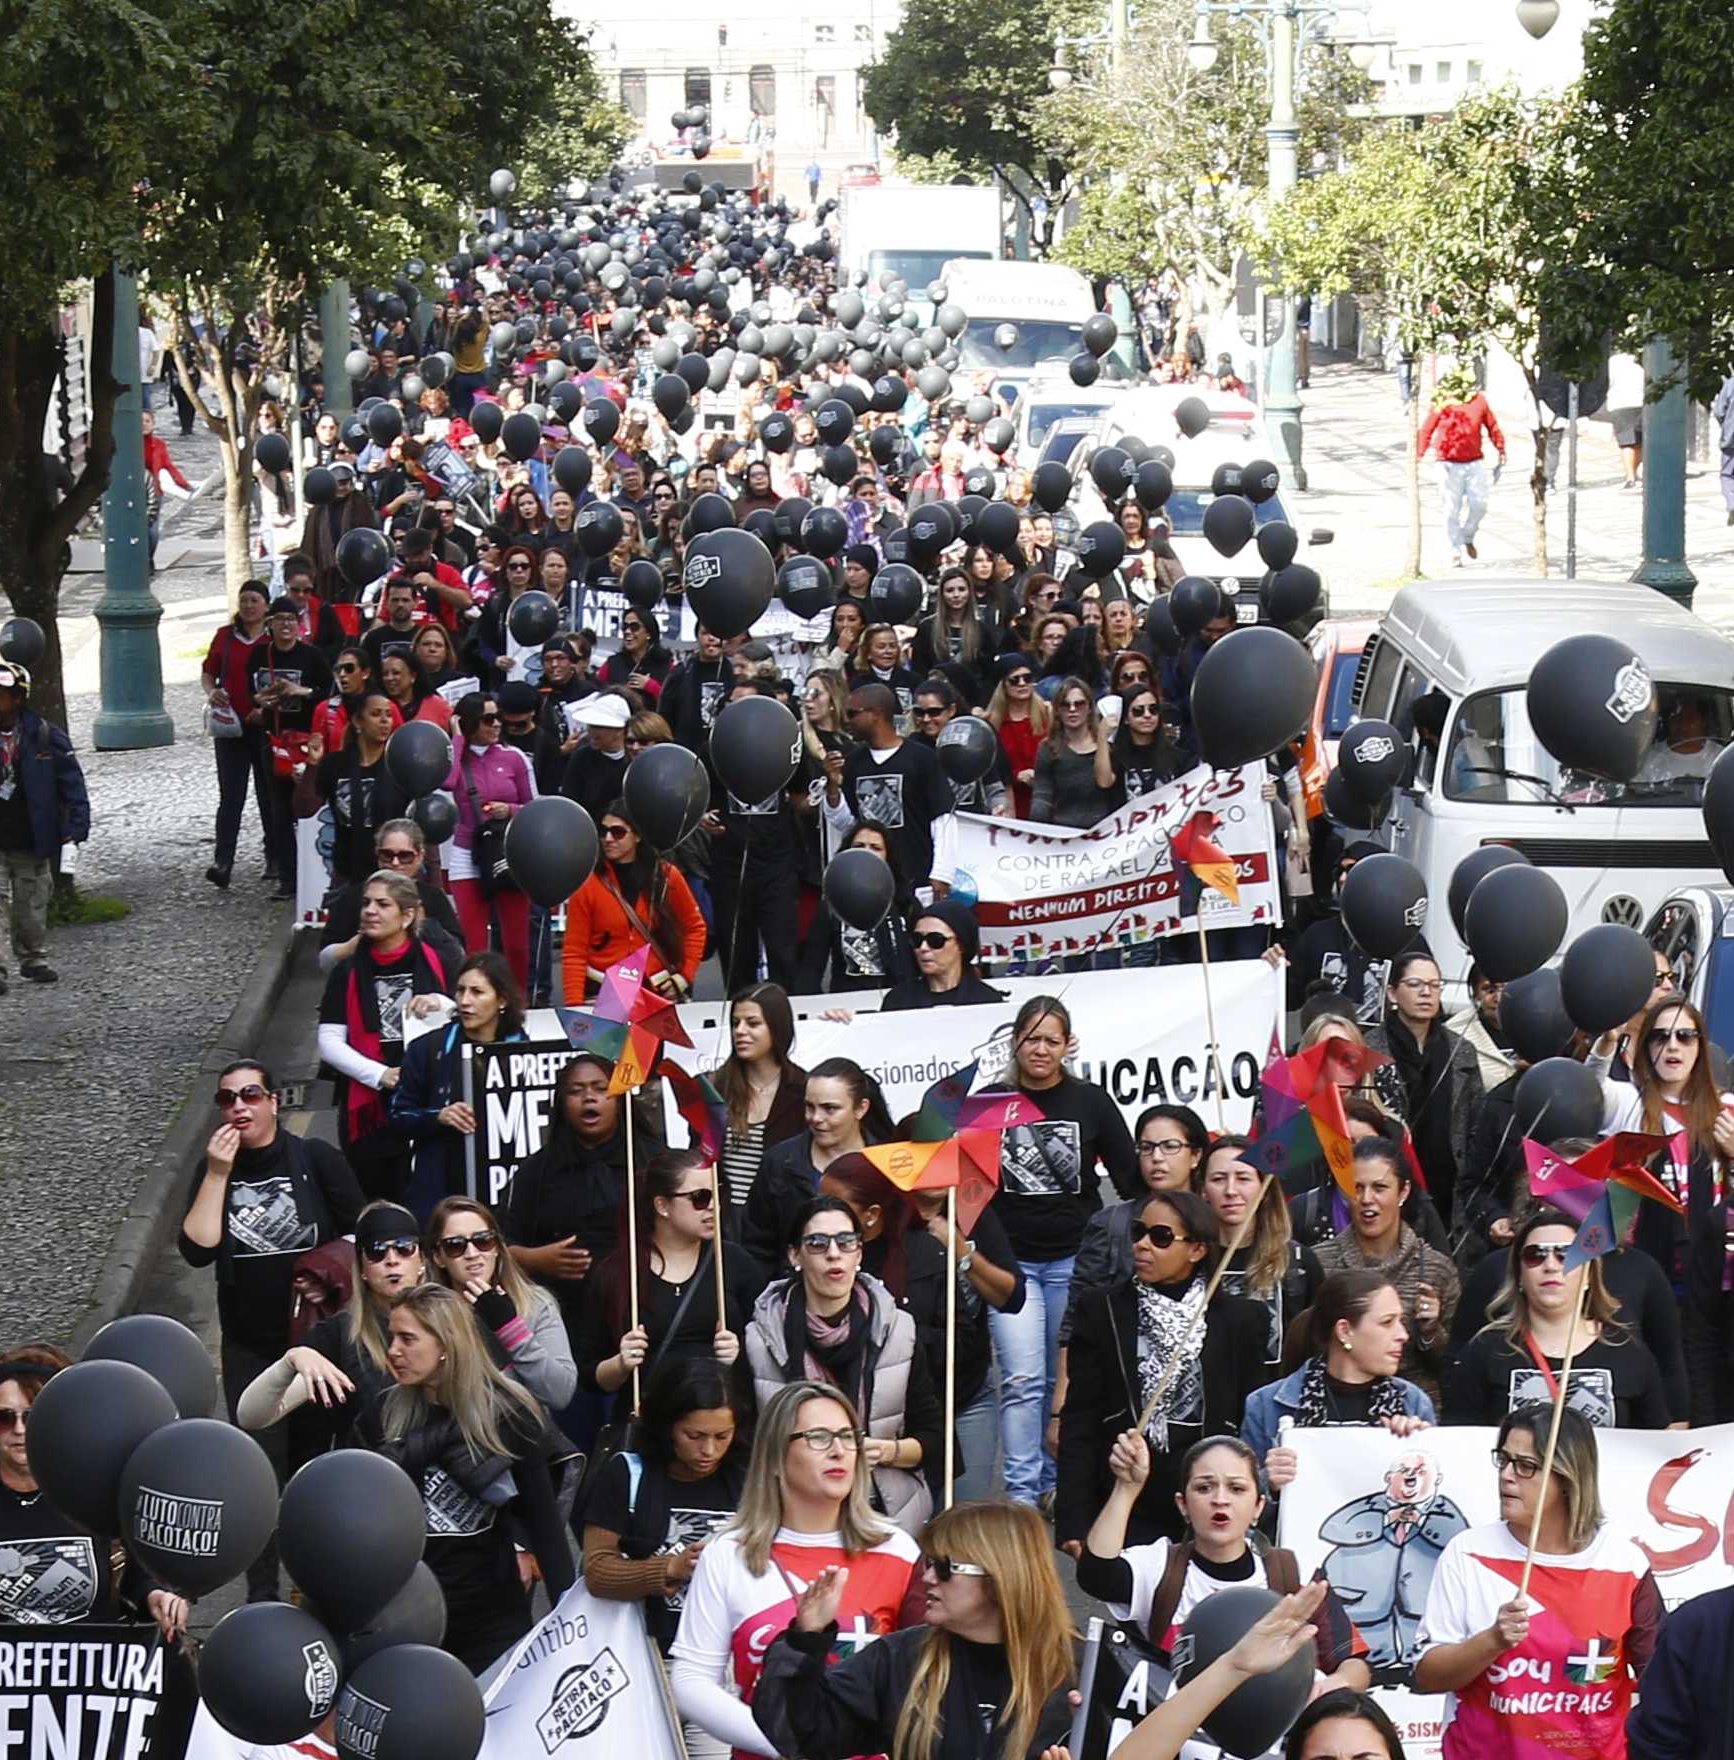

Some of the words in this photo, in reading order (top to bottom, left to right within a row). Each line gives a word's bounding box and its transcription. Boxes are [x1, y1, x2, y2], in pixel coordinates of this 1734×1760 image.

[975, 294, 1069, 308] PALOTINA
[996, 852, 1091, 872] CONTRA
[1102, 846, 1119, 860] O
[1023, 874, 1052, 892] DE
[1060, 863, 1146, 888] RAFAEL
[1007, 896, 1087, 922] NENHUM
[1094, 881, 1169, 908] DIREITO
[485, 1055, 505, 1089] A
[243, 1205, 267, 1227] LUTA
[139, 1516, 220, 1556] PACOTAÇO!
[3, 1573, 36, 1602] LUTA
[552, 1678, 589, 1722] RETIRA
[588, 1669, 601, 1686] O
[1118, 1660, 1149, 1717] A
[1489, 1690, 1614, 1716] MUNICIPAIS
